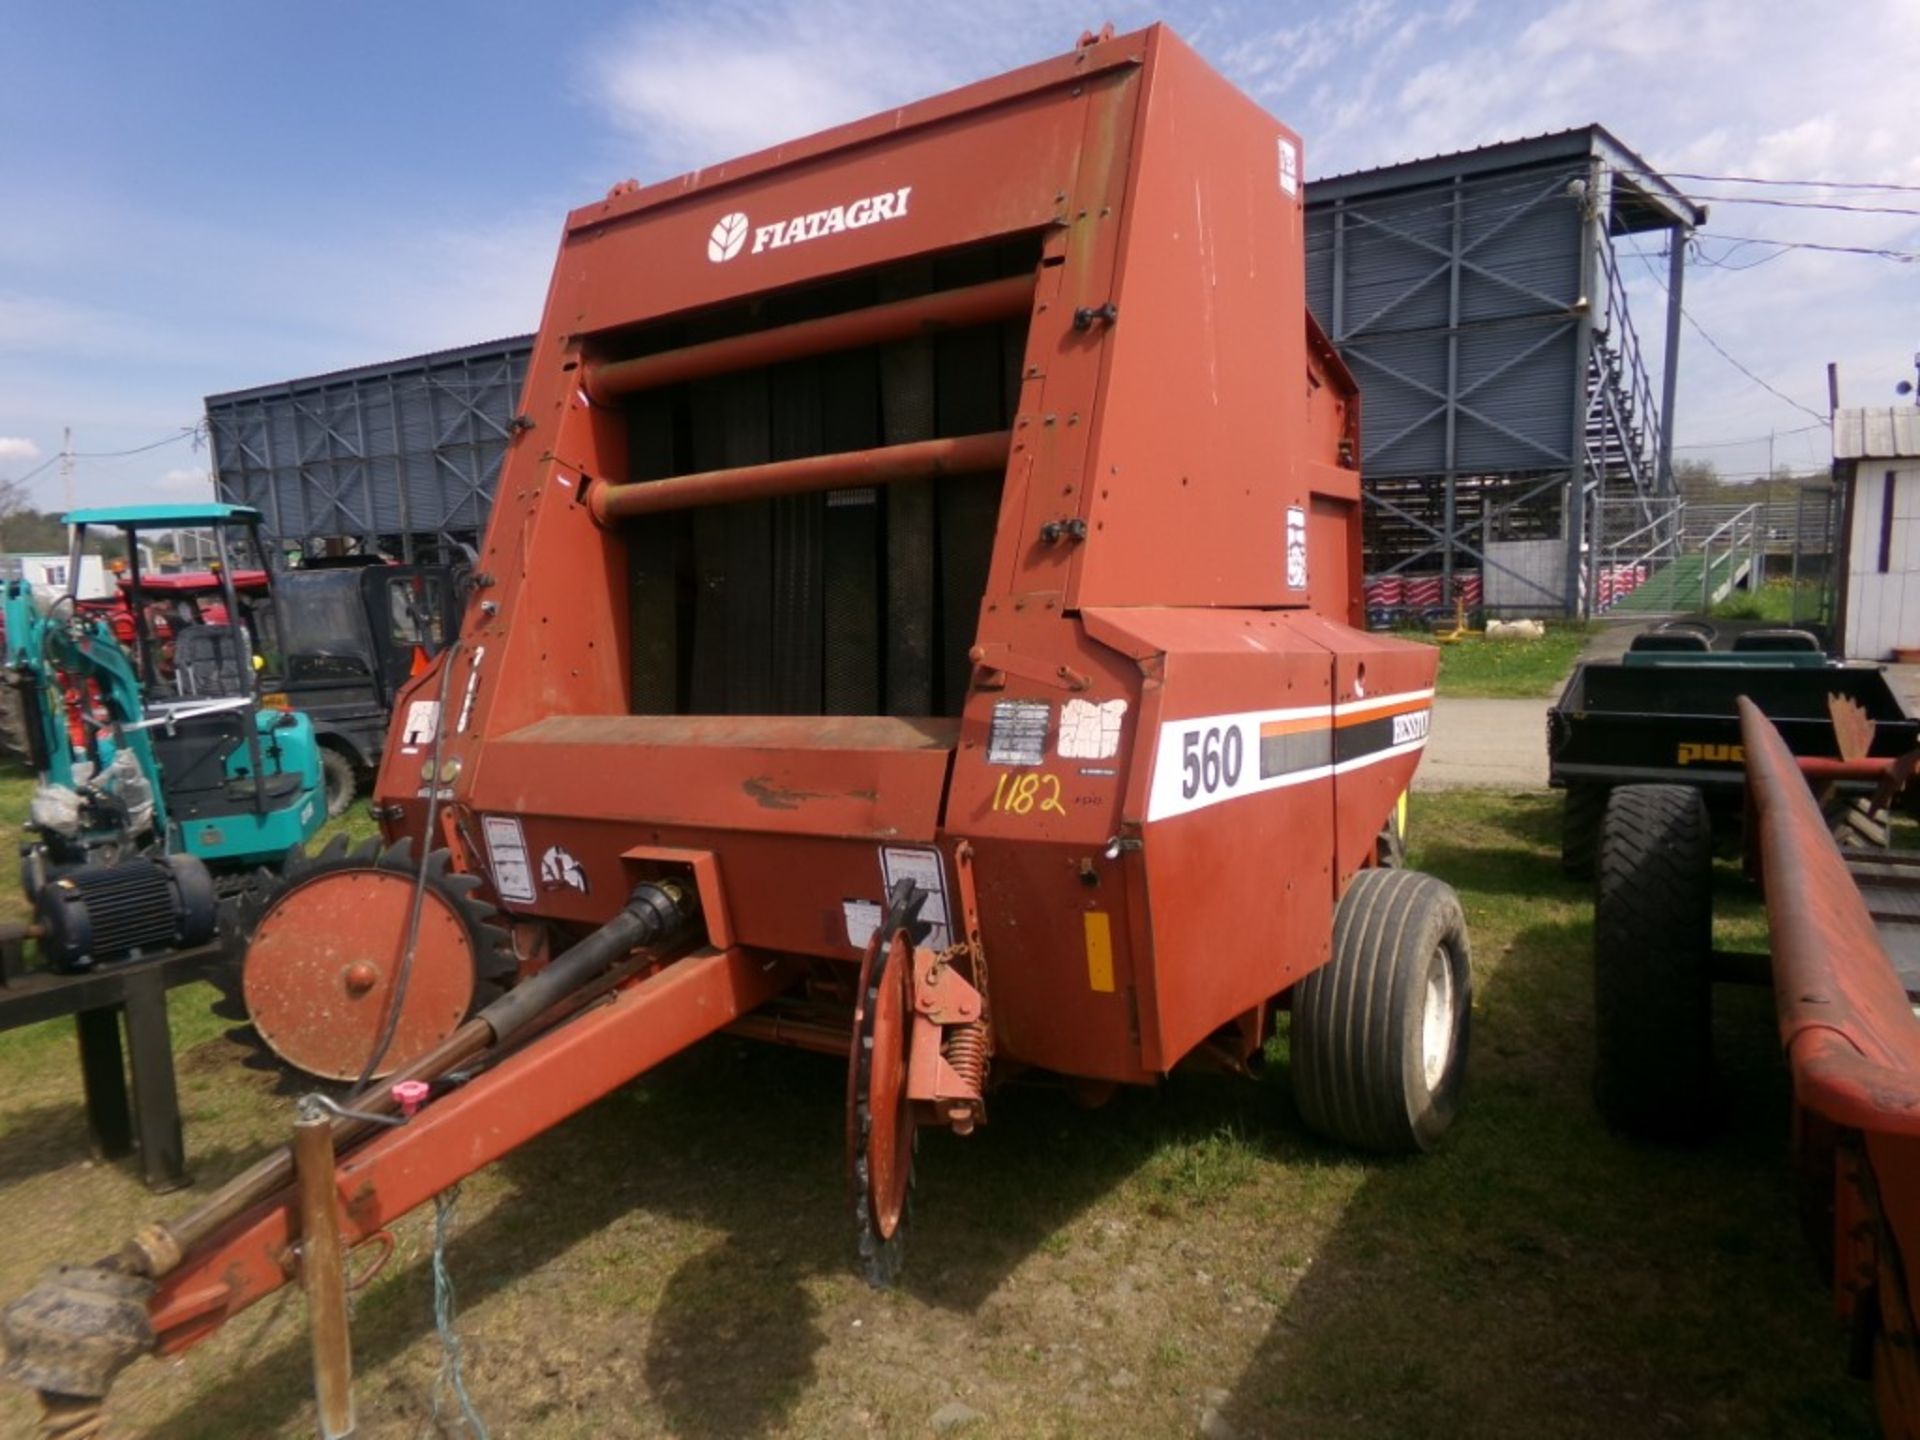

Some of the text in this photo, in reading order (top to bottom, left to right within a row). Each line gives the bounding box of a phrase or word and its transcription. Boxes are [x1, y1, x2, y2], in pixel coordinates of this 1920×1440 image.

[751, 187, 912, 254] FIATAGRI
[992, 772, 1066, 816] 1182
[1182, 724, 1244, 800] 560
